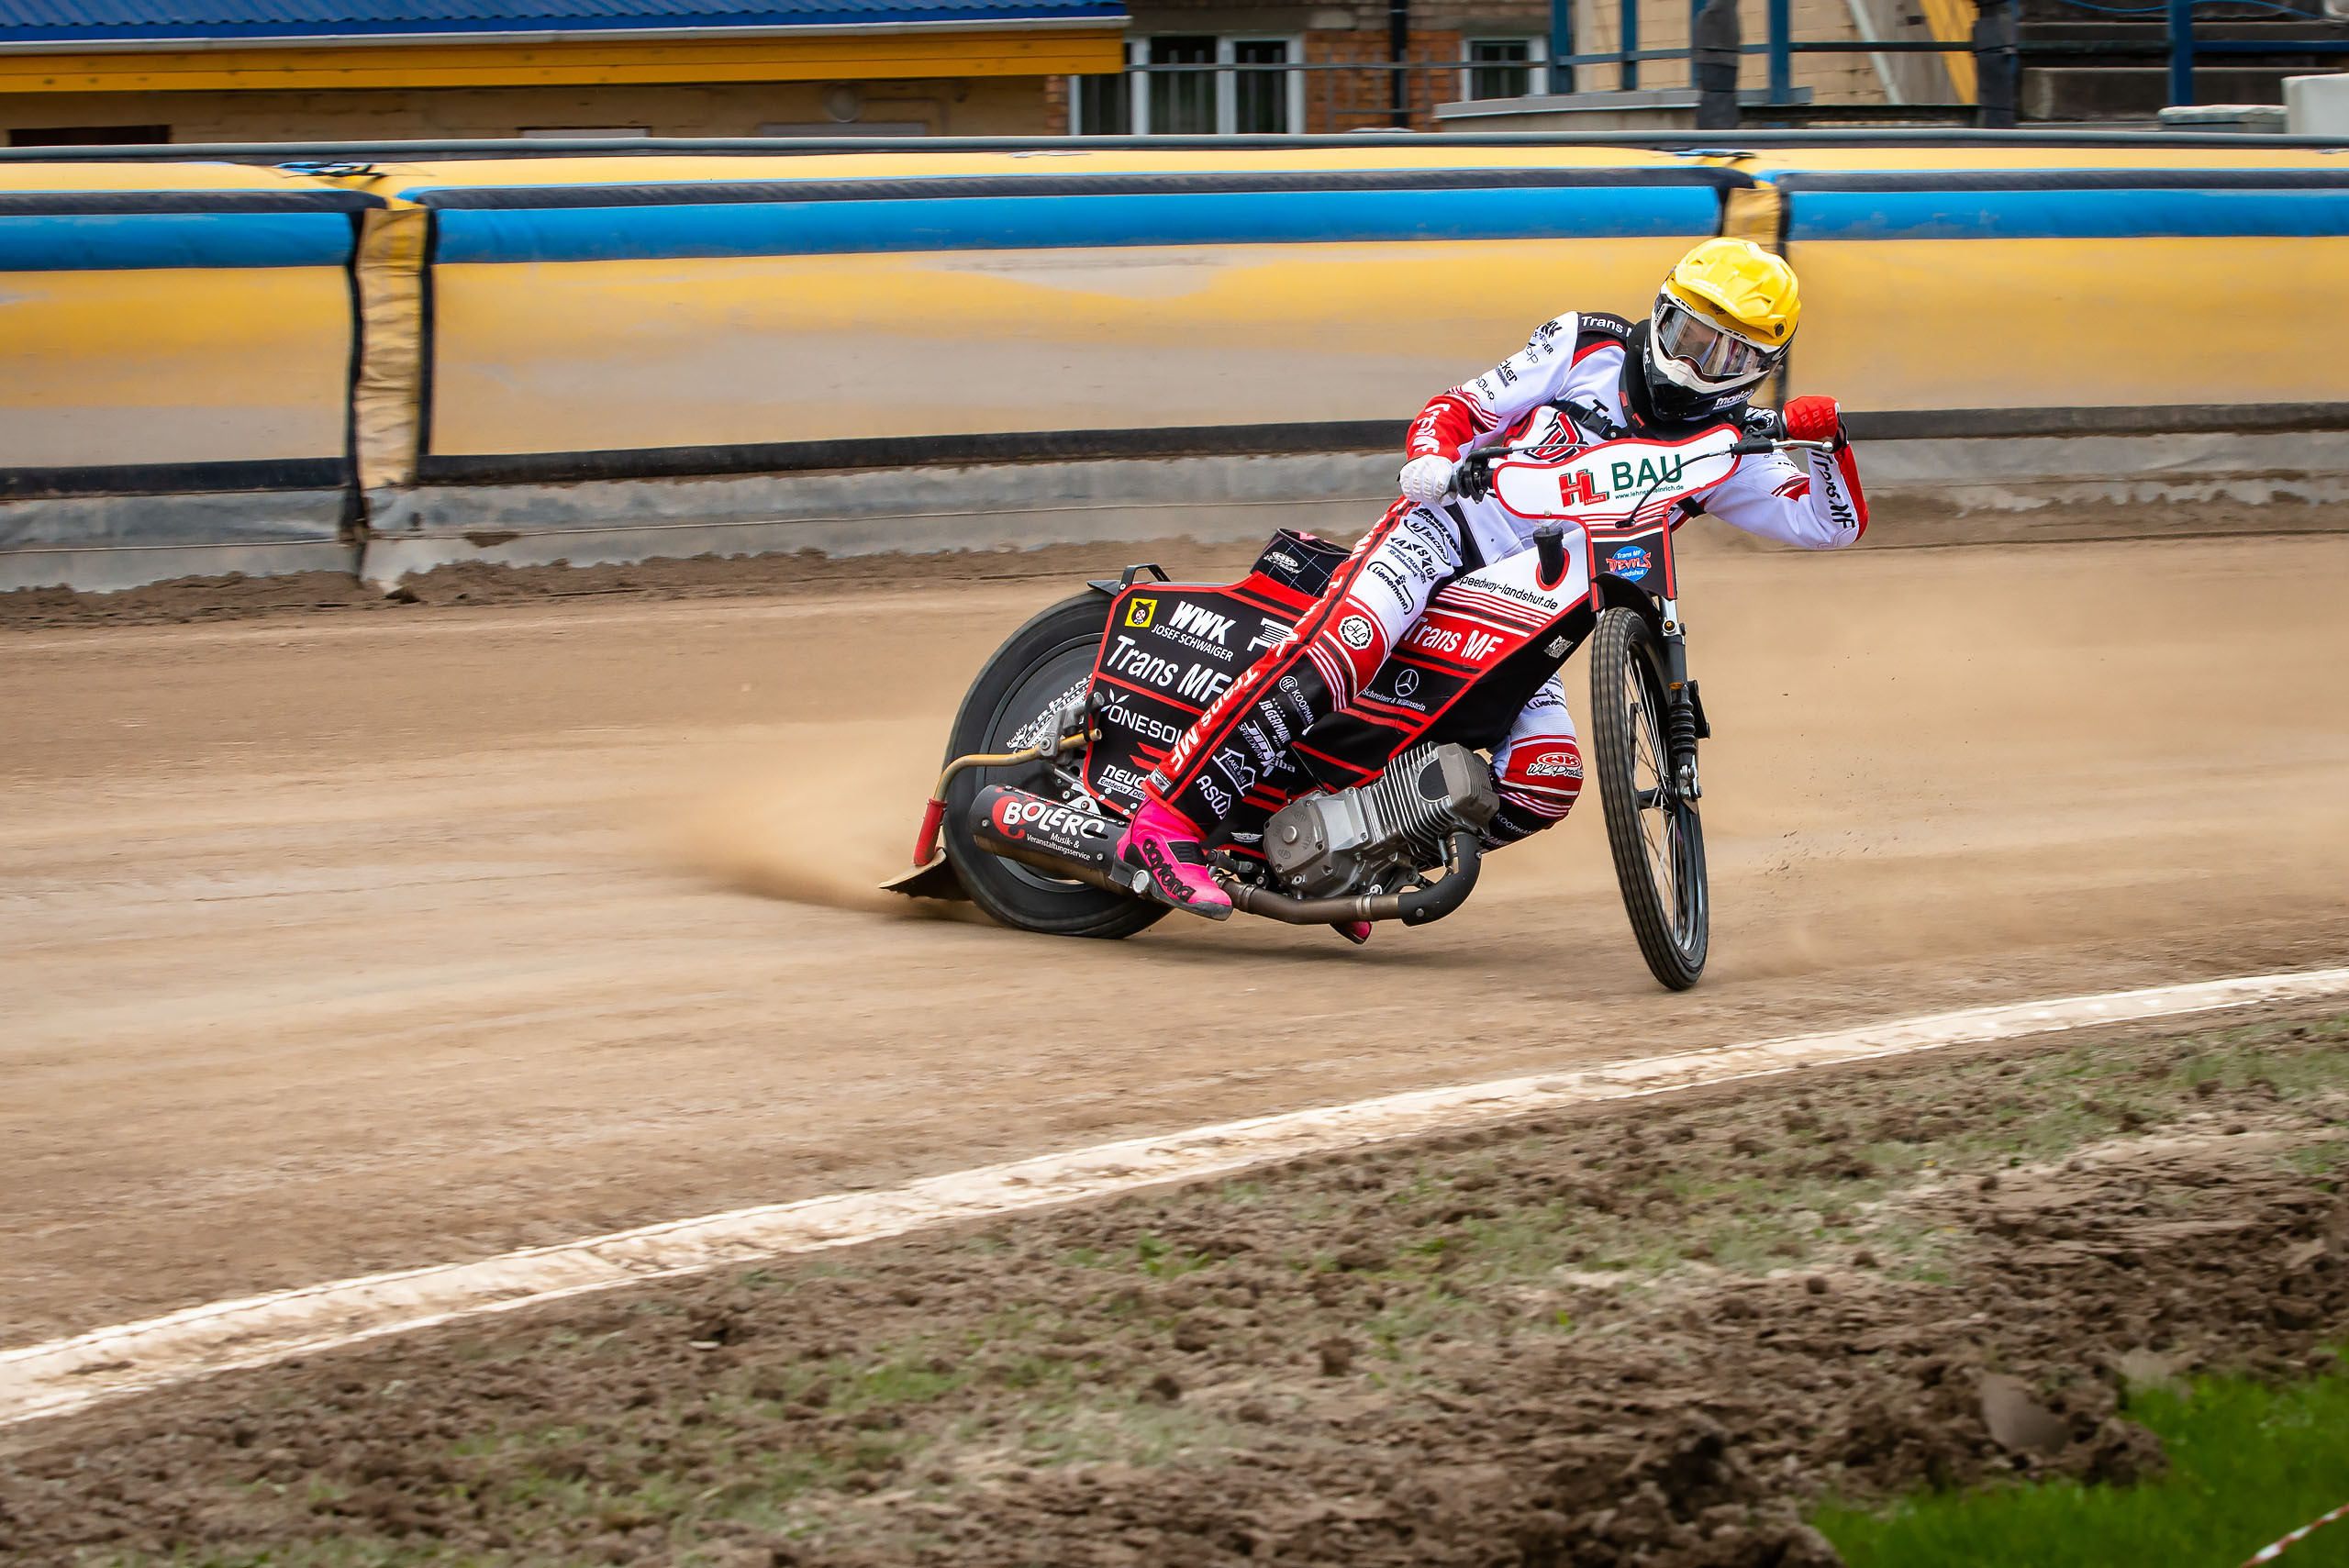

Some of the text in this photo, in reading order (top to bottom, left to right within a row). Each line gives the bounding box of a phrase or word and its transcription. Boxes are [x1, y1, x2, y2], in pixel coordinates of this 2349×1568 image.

[1581, 316, 1623, 333] Trans
[1559, 469, 1609, 507] HL
[1611, 454, 1683, 491] BAU
[1606, 551, 1652, 573] DEVILS
[1372, 567, 1409, 611] Lienemann
[1169, 600, 1236, 645] WWK
[1404, 617, 1462, 652] Trans
[1461, 629, 1504, 661] MF
[1152, 624, 1234, 662] JOSEF SCHWAIGER
[1107, 635, 1232, 702] Trans MF
[1201, 668, 1259, 727] Trans
[1100, 778, 1128, 793] Entdecke
[1003, 800, 1106, 840] BOLERO
[1027, 834, 1091, 861] Veranstaltungsservice
[1051, 833, 1080, 849] Musik- &
[1142, 839, 1197, 903] daytona
